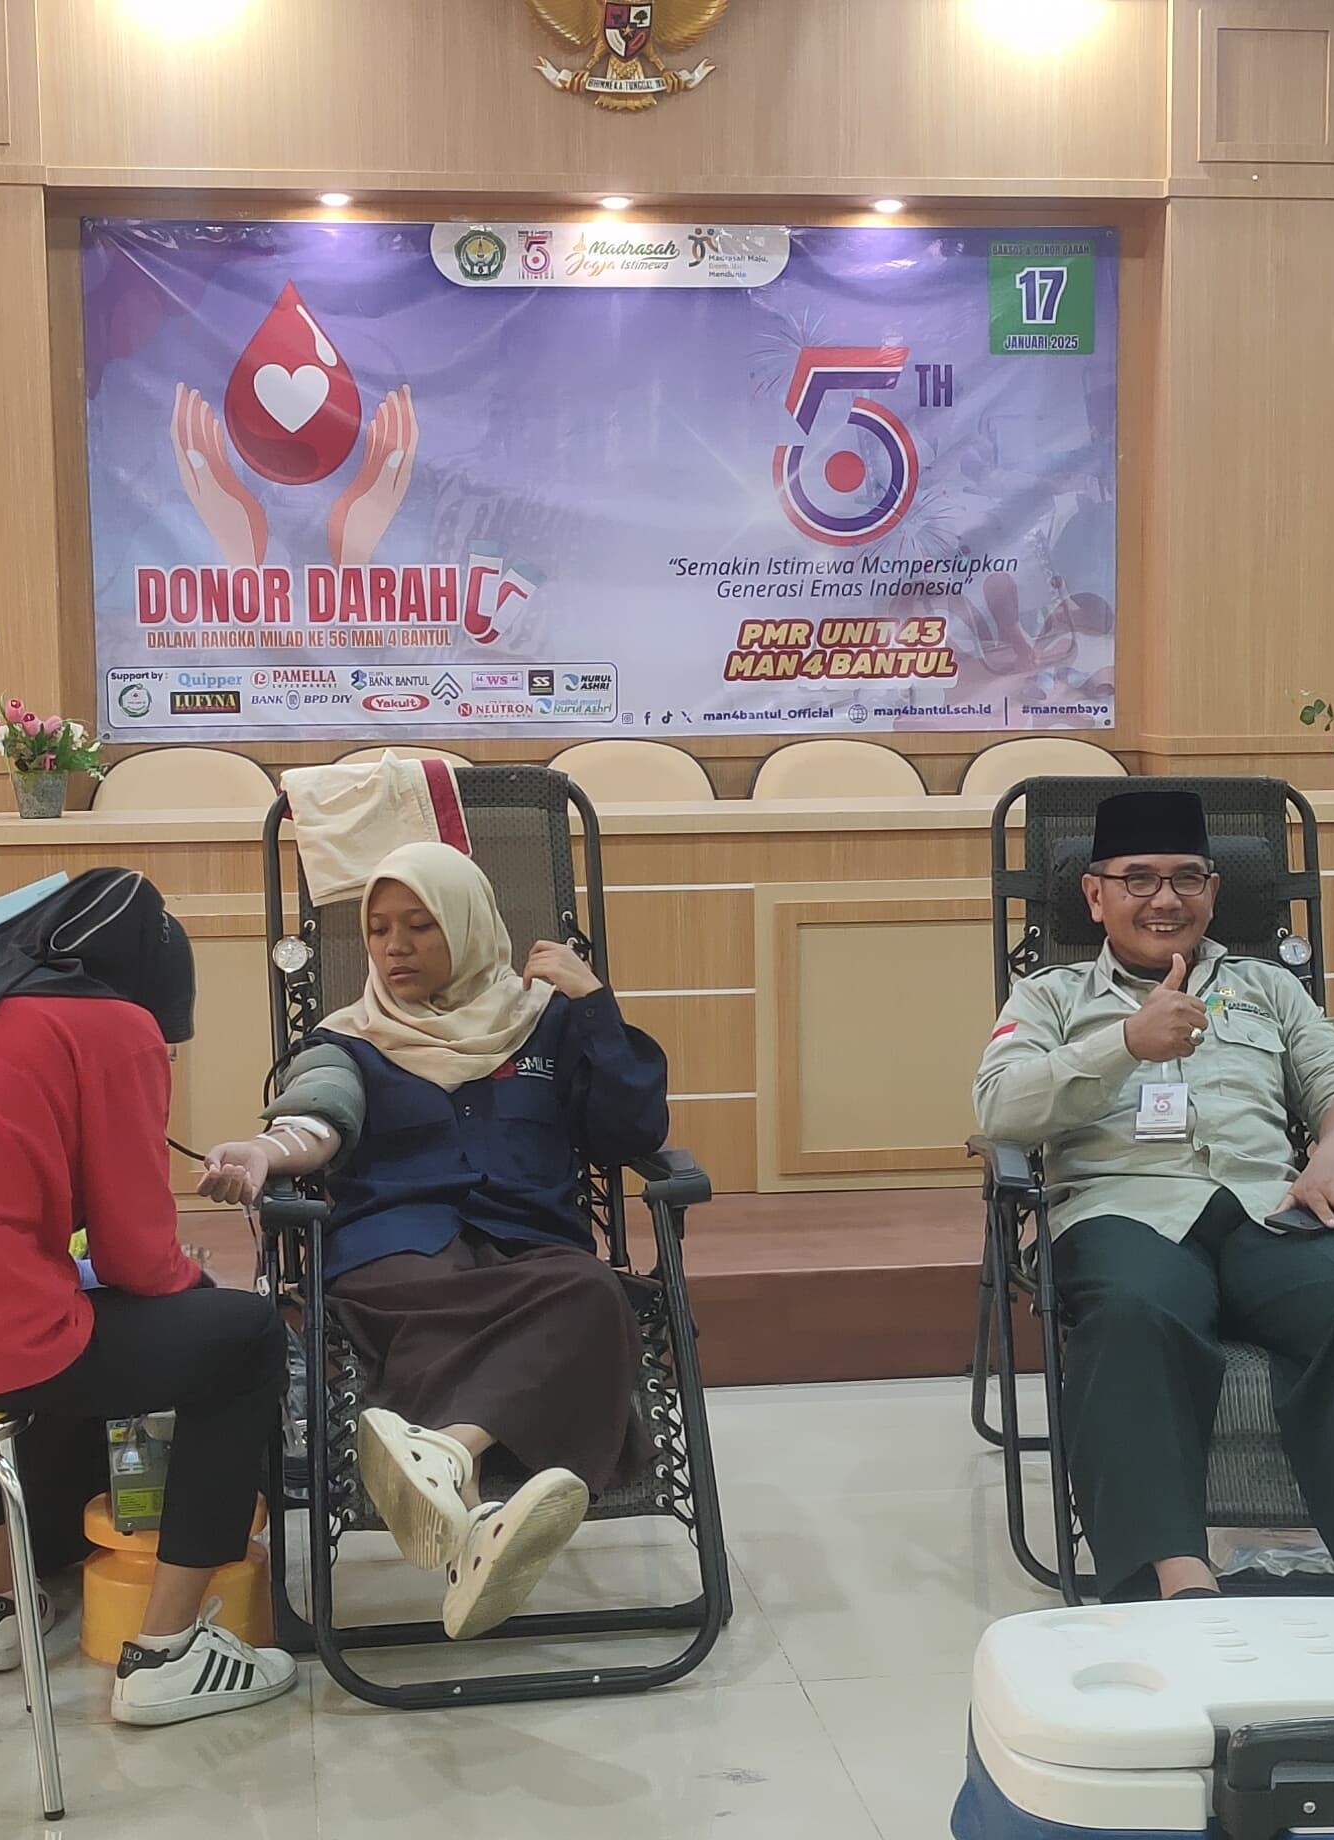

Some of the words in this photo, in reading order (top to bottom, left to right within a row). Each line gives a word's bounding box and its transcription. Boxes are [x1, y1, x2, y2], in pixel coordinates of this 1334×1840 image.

[588, 239, 680, 261] Madrasah
[564, 251, 616, 277] Jogja
[620, 259, 669, 270] Istimewa
[1017, 268, 1066, 323] 17
[1005, 335, 1048, 349] JANUARI
[1051, 335, 1079, 349] 2025
[915, 364, 954, 408] TH
[766, 556, 855, 575] Istimewa
[137, 567, 291, 624] DONOR
[307, 567, 458, 623] DARAH
[717, 579, 804, 599] Generasi
[810, 579, 863, 598] Emas
[147, 630, 197, 648] DALAM
[201, 630, 256, 648] RANGKA
[260, 630, 304, 648] MILAD
[308, 630, 324, 647] KE
[329, 630, 347, 647] 56
[351, 630, 383, 647] MAN
[388, 630, 397, 647] 4
[401, 629, 452, 647] BANTUL
[740, 622, 811, 647] PMR
[821, 621, 896, 645] UNIT
[898, 620, 943, 644] 43
[727, 653, 799, 678] MAN
[801, 653, 823, 677] 4
[829, 651, 955, 676] BANTUL
[111, 672, 149, 682] Support
[178, 672, 243, 689] Quipper
[272, 669, 336, 683] PAMELLA
[369, 676, 394, 687] BANK
[395, 675, 430, 686] BANTUL
[532, 676, 550, 687] SS
[580, 674, 612, 682] NURUL
[580, 682, 610, 690] ASHRI
[251, 695, 284, 705] BANK
[304, 694, 328, 704] BPD
[331, 694, 353, 704] DIY
[375, 697, 418, 708] Yakult
[475, 704, 534, 714] NEUTRON
[555, 704, 582, 713] Nurul
[584, 703, 612, 713] Ashri
[1021, 703, 1109, 716] #manembayo
[515, 1056, 554, 1074] SMILE
